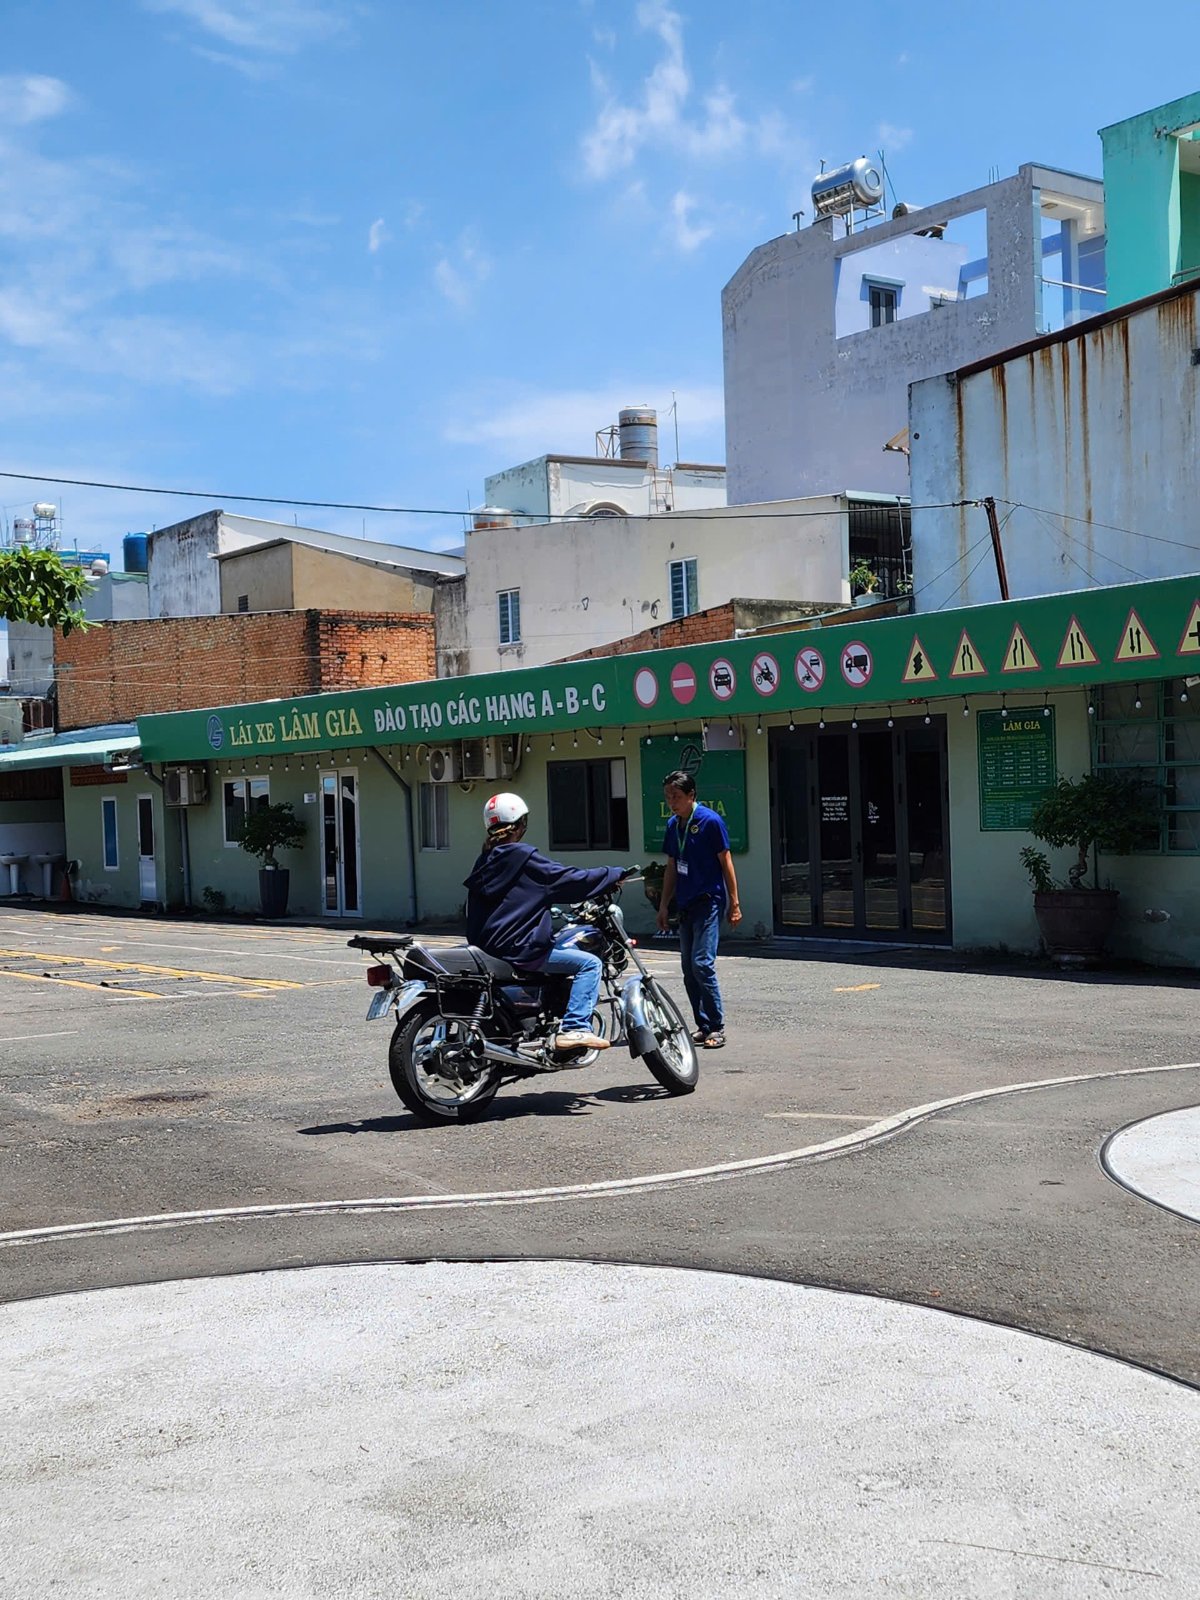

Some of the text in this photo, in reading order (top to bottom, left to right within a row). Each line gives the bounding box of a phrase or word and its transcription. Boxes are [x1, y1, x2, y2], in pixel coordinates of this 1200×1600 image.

[374, 702, 406, 733] ĐÀO
[409, 702, 442, 733] TẠO
[446, 692, 481, 726] CÁC
[485, 691, 536, 726] HẠNG
[1024, 721, 1041, 730] GIA
[229, 707, 363, 746] LÁI XE LÂM GIA
[702, 800, 726, 817] IA
